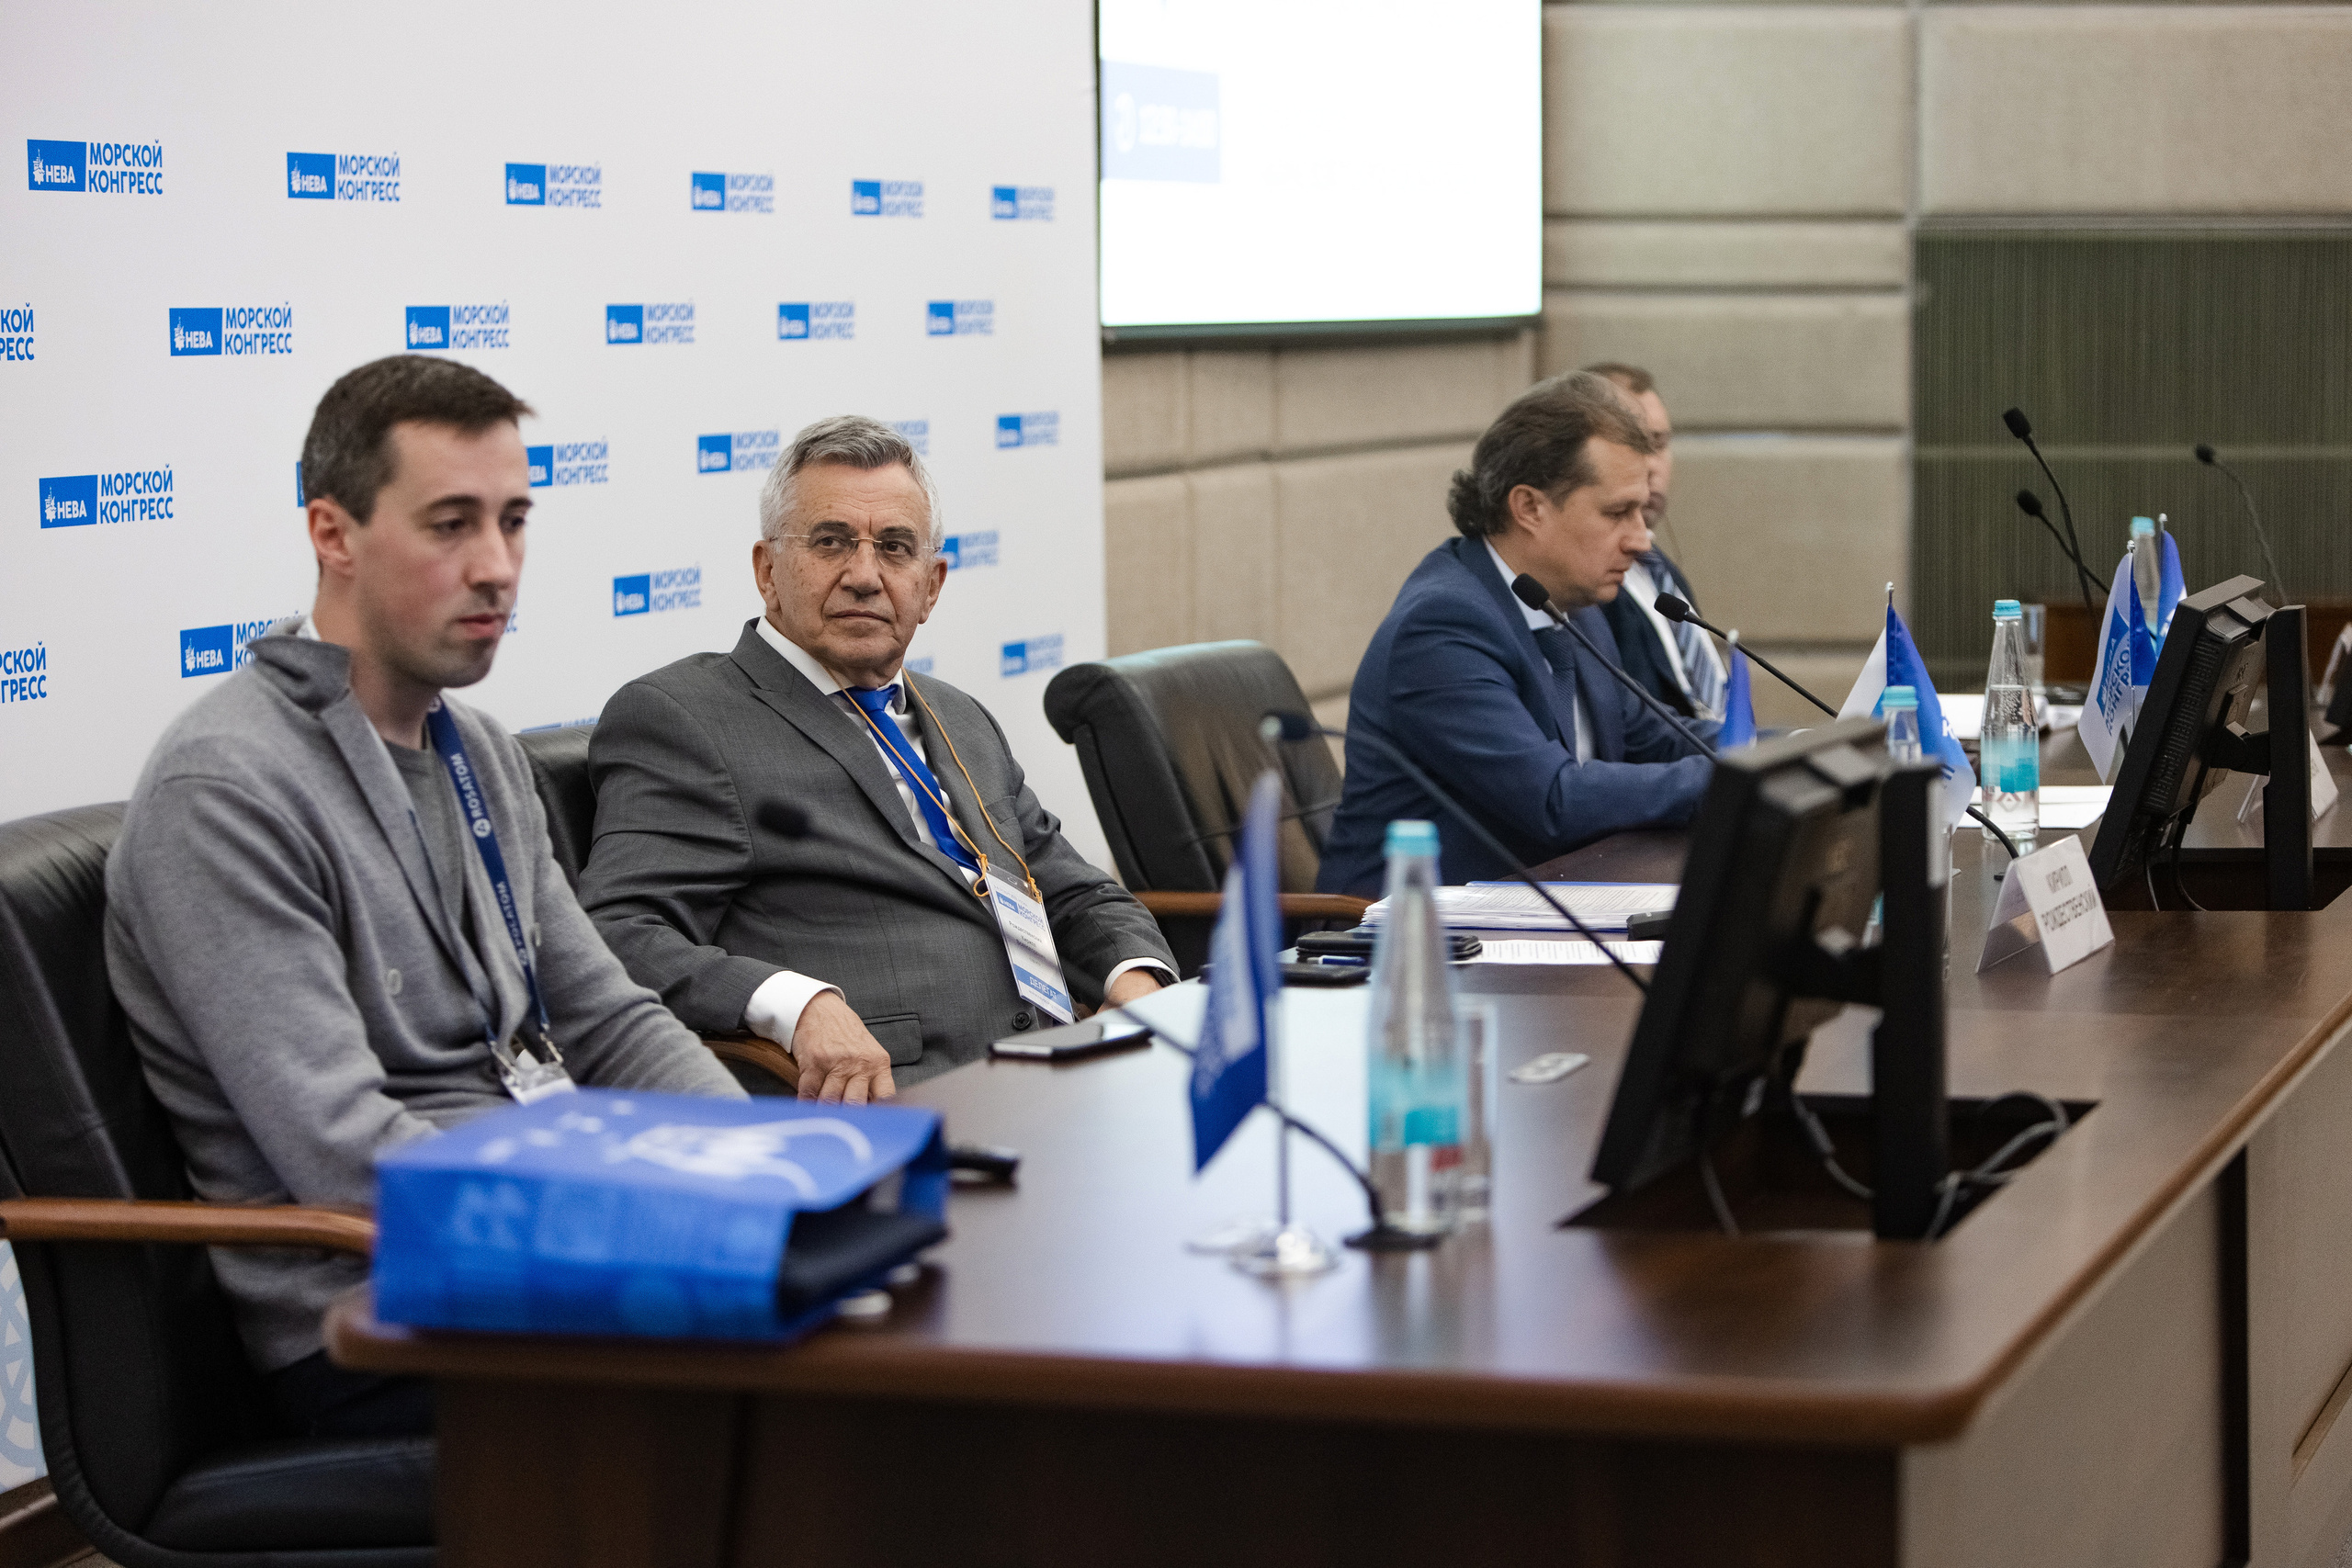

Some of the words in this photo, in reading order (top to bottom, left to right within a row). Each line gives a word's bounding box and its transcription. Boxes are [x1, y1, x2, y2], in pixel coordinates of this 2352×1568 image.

[90, 139, 164, 168] МОРСКОЙ
[338, 152, 401, 177] МОРСКОЙ
[46, 164, 76, 184] НЕВА
[89, 169, 164, 195] КОНГРЕСС
[300, 175, 328, 193] НЕВА
[549, 161, 602, 185] МОРСКОЙ
[337, 180, 401, 201] КОНГРЕСС
[548, 188, 602, 208] КОНГРЕСС
[226, 301, 292, 329] МОРСКОЙ
[453, 299, 509, 324] МОРСКОЙ
[185, 331, 213, 349] НЕВА
[225, 333, 292, 355] КОНГРЕСС
[451, 329, 510, 349] КОНГРЕСС
[101, 463, 174, 497] МОРСКОЙ
[57, 500, 87, 520] НЕВА
[100, 496, 175, 525] КОНГРЕСС
[196, 649, 224, 670] НЕВА
[1, 674, 48, 704] ГРЕСС
[450, 753, 483, 818] ROSATOM
[1029, 976, 1057, 1000] ДЕЛЕГАТ
